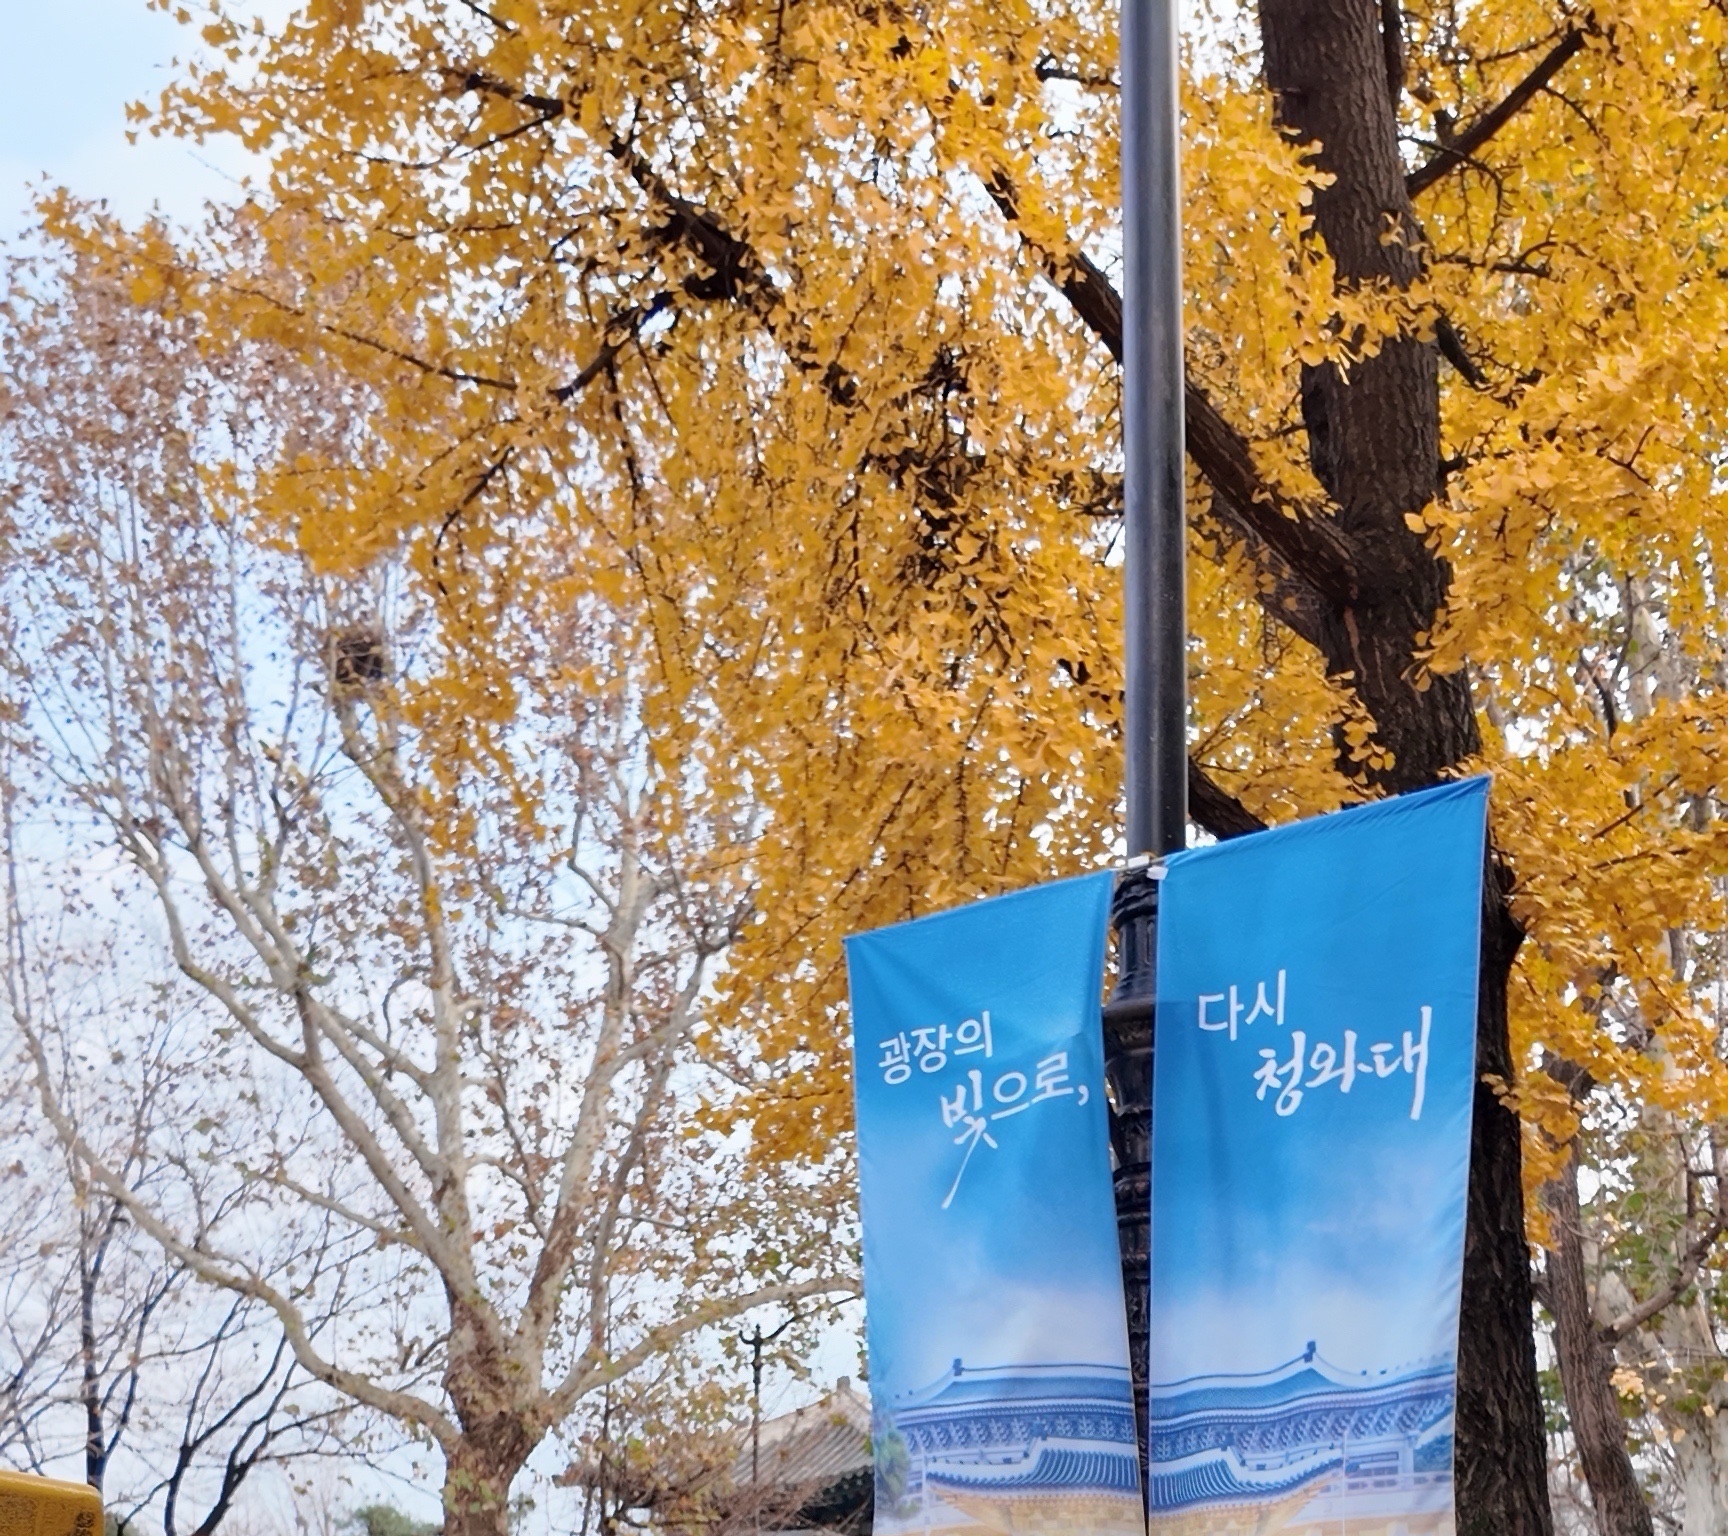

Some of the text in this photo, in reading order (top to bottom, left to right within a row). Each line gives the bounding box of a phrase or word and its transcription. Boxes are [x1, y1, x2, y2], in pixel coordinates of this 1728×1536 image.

[878, 1010, 993, 1085] 광장의
[1198, 968, 1287, 1041] 다시
[1252, 1005, 1433, 1121] 청와대
[940, 1052, 1089, 1209] 빛으로,
